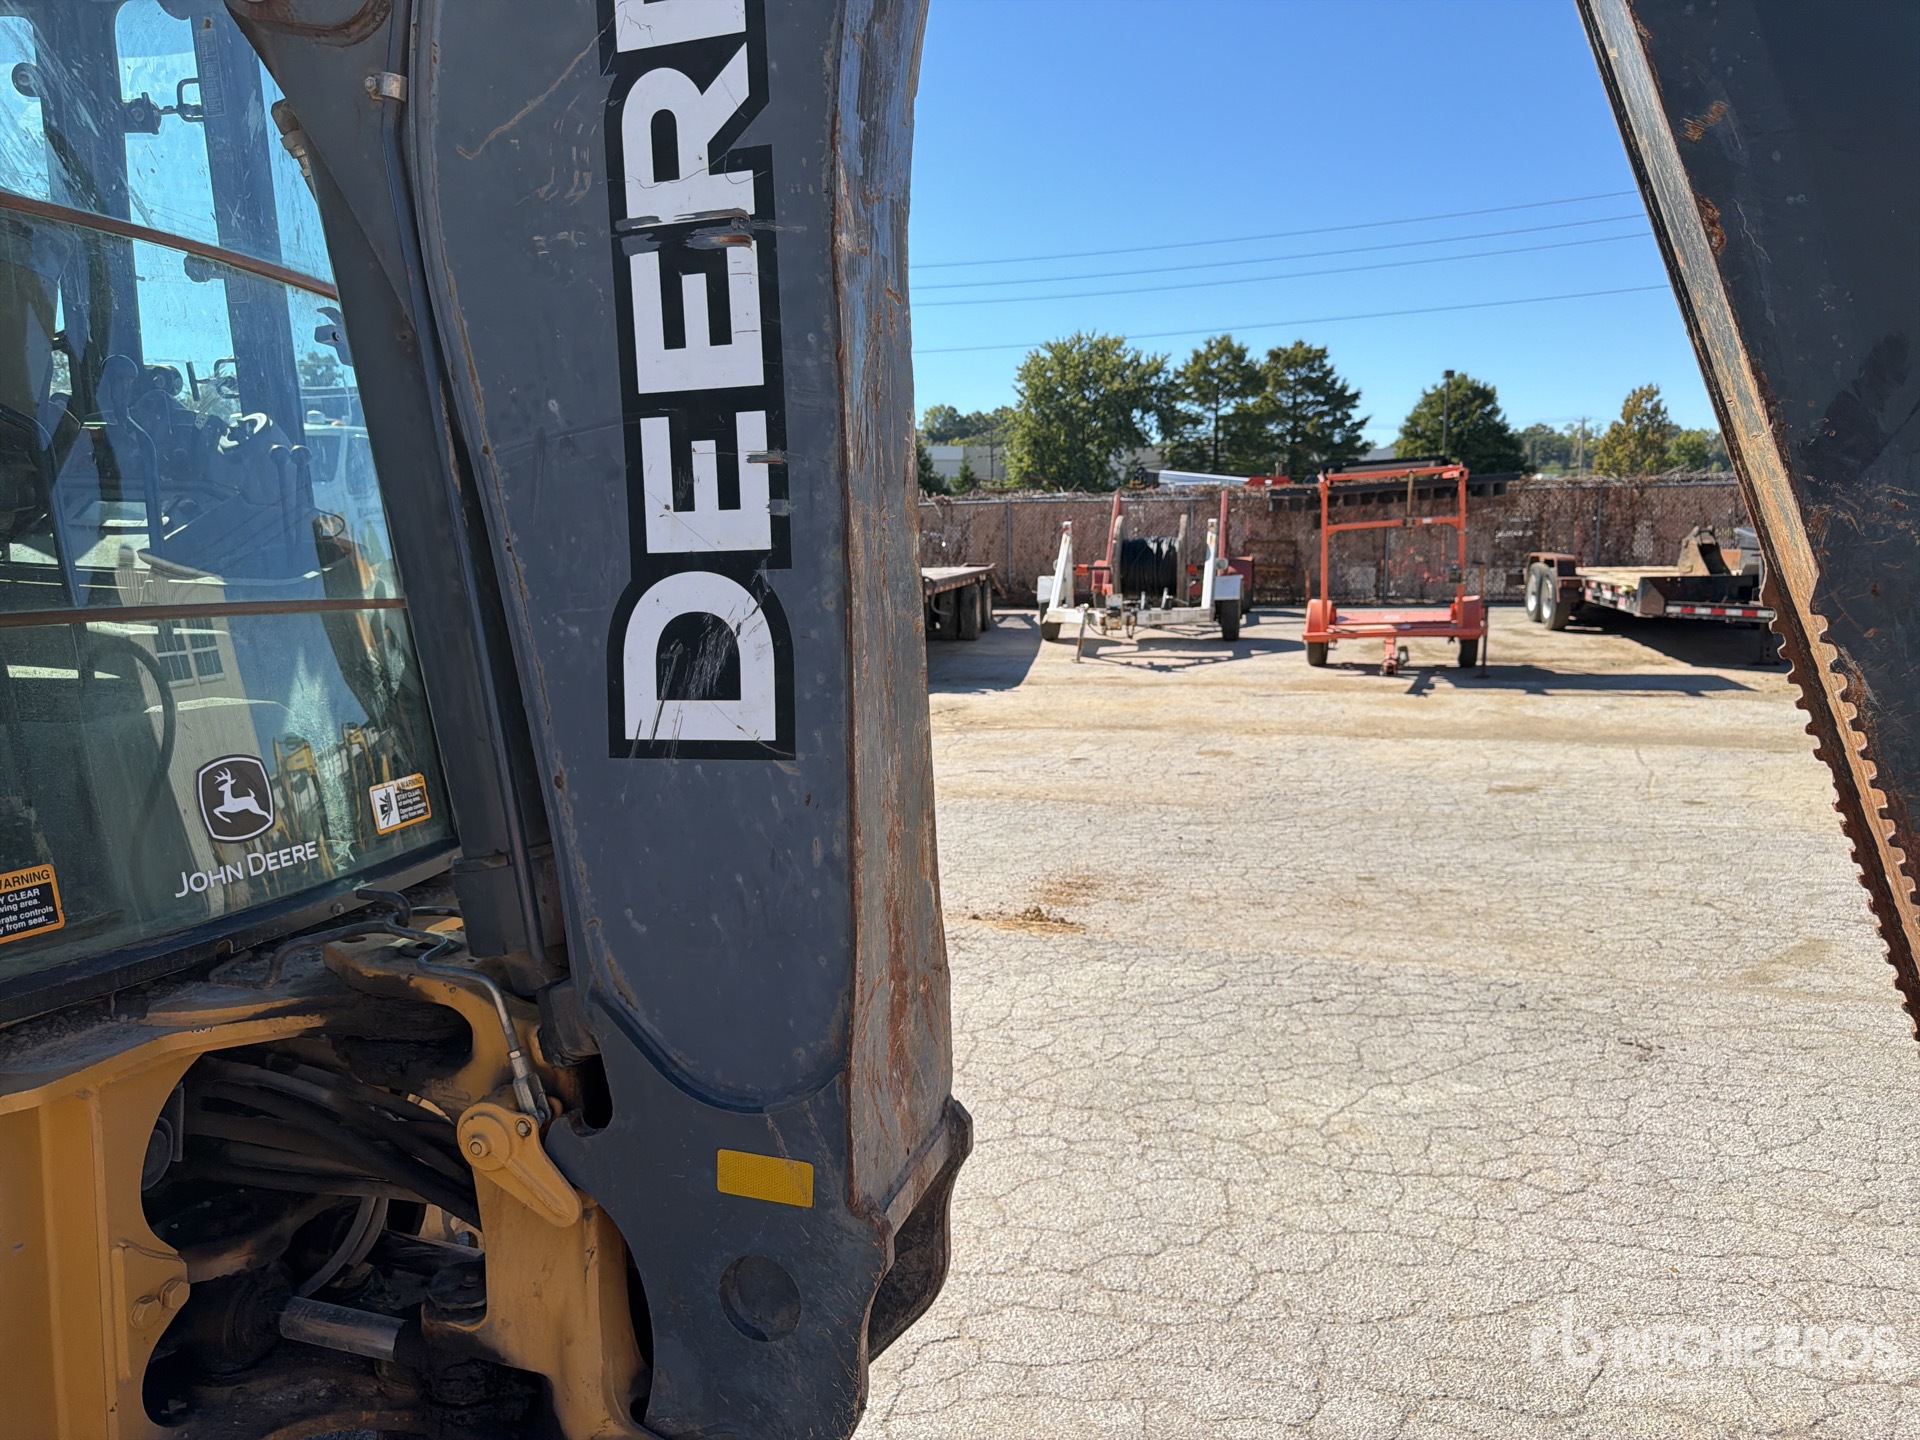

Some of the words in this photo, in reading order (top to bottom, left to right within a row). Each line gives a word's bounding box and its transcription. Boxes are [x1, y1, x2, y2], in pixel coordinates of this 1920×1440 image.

[174, 861, 244, 898] JOHN
[246, 841, 319, 876] DEERE
[0, 869, 50, 890] ARNING
[7, 888, 40, 903] CLEAR
[20, 898, 40, 908] area.
[0, 914, 18, 925] rate
[19, 905, 54, 919] controls
[6, 921, 26, 931] from
[28, 915, 48, 926] seat.
